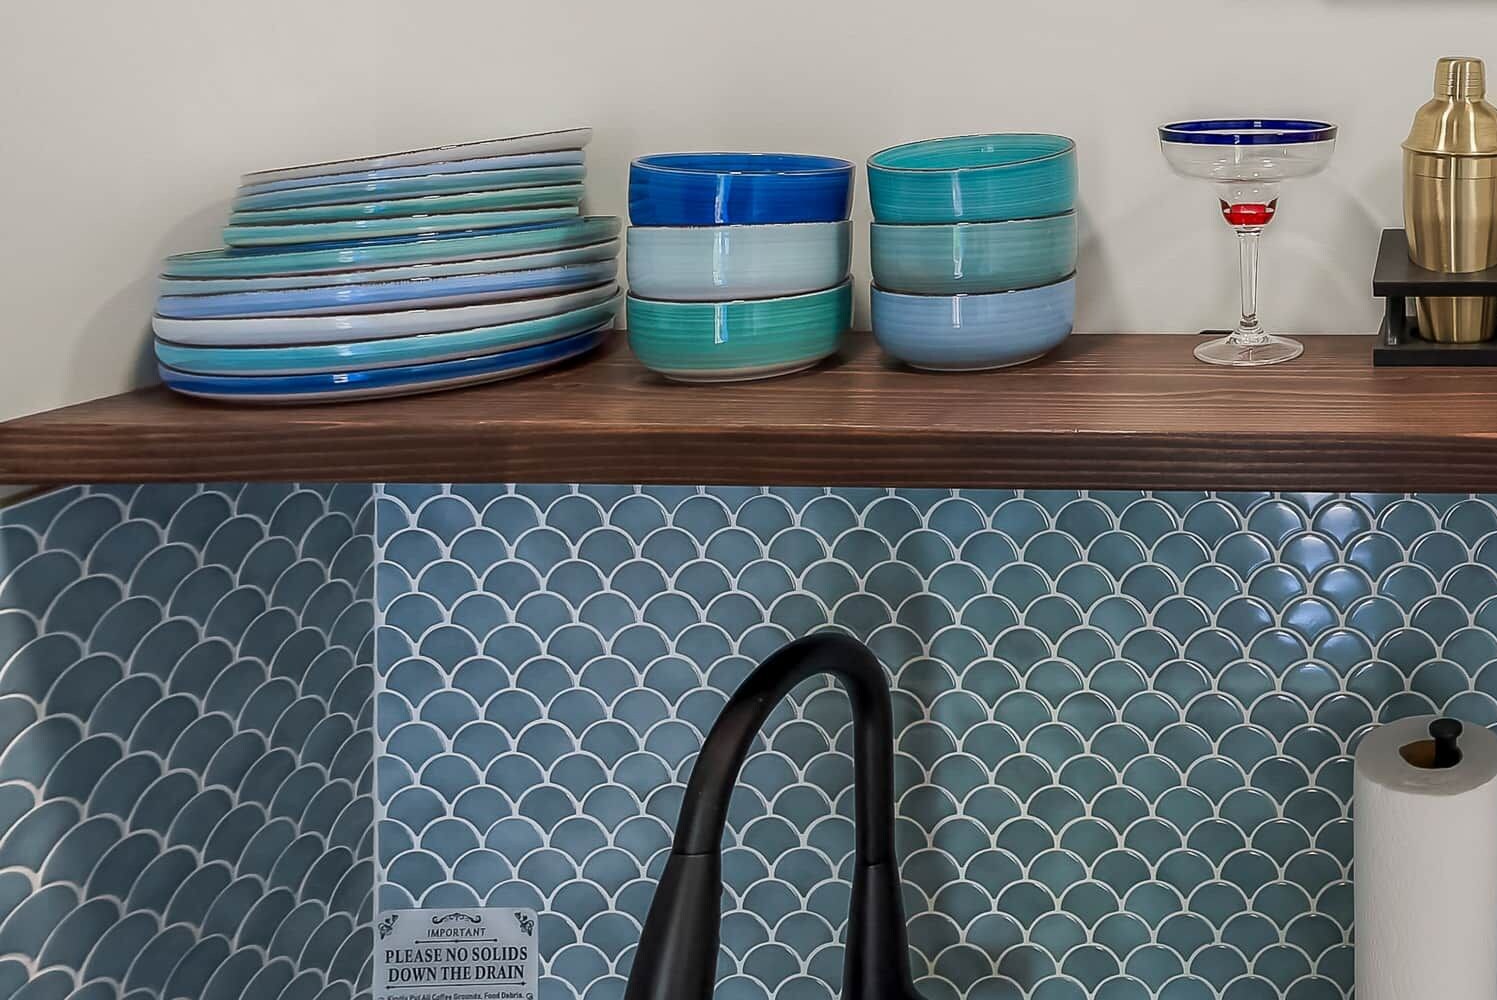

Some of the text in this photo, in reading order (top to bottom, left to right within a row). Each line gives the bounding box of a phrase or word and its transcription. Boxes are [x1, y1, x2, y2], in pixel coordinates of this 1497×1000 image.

[427, 928, 486, 937] IMPORTANT
[385, 946, 528, 963] PLEASE NO SOLIDS
[388, 965, 525, 982] DOWN THE DRAIN
